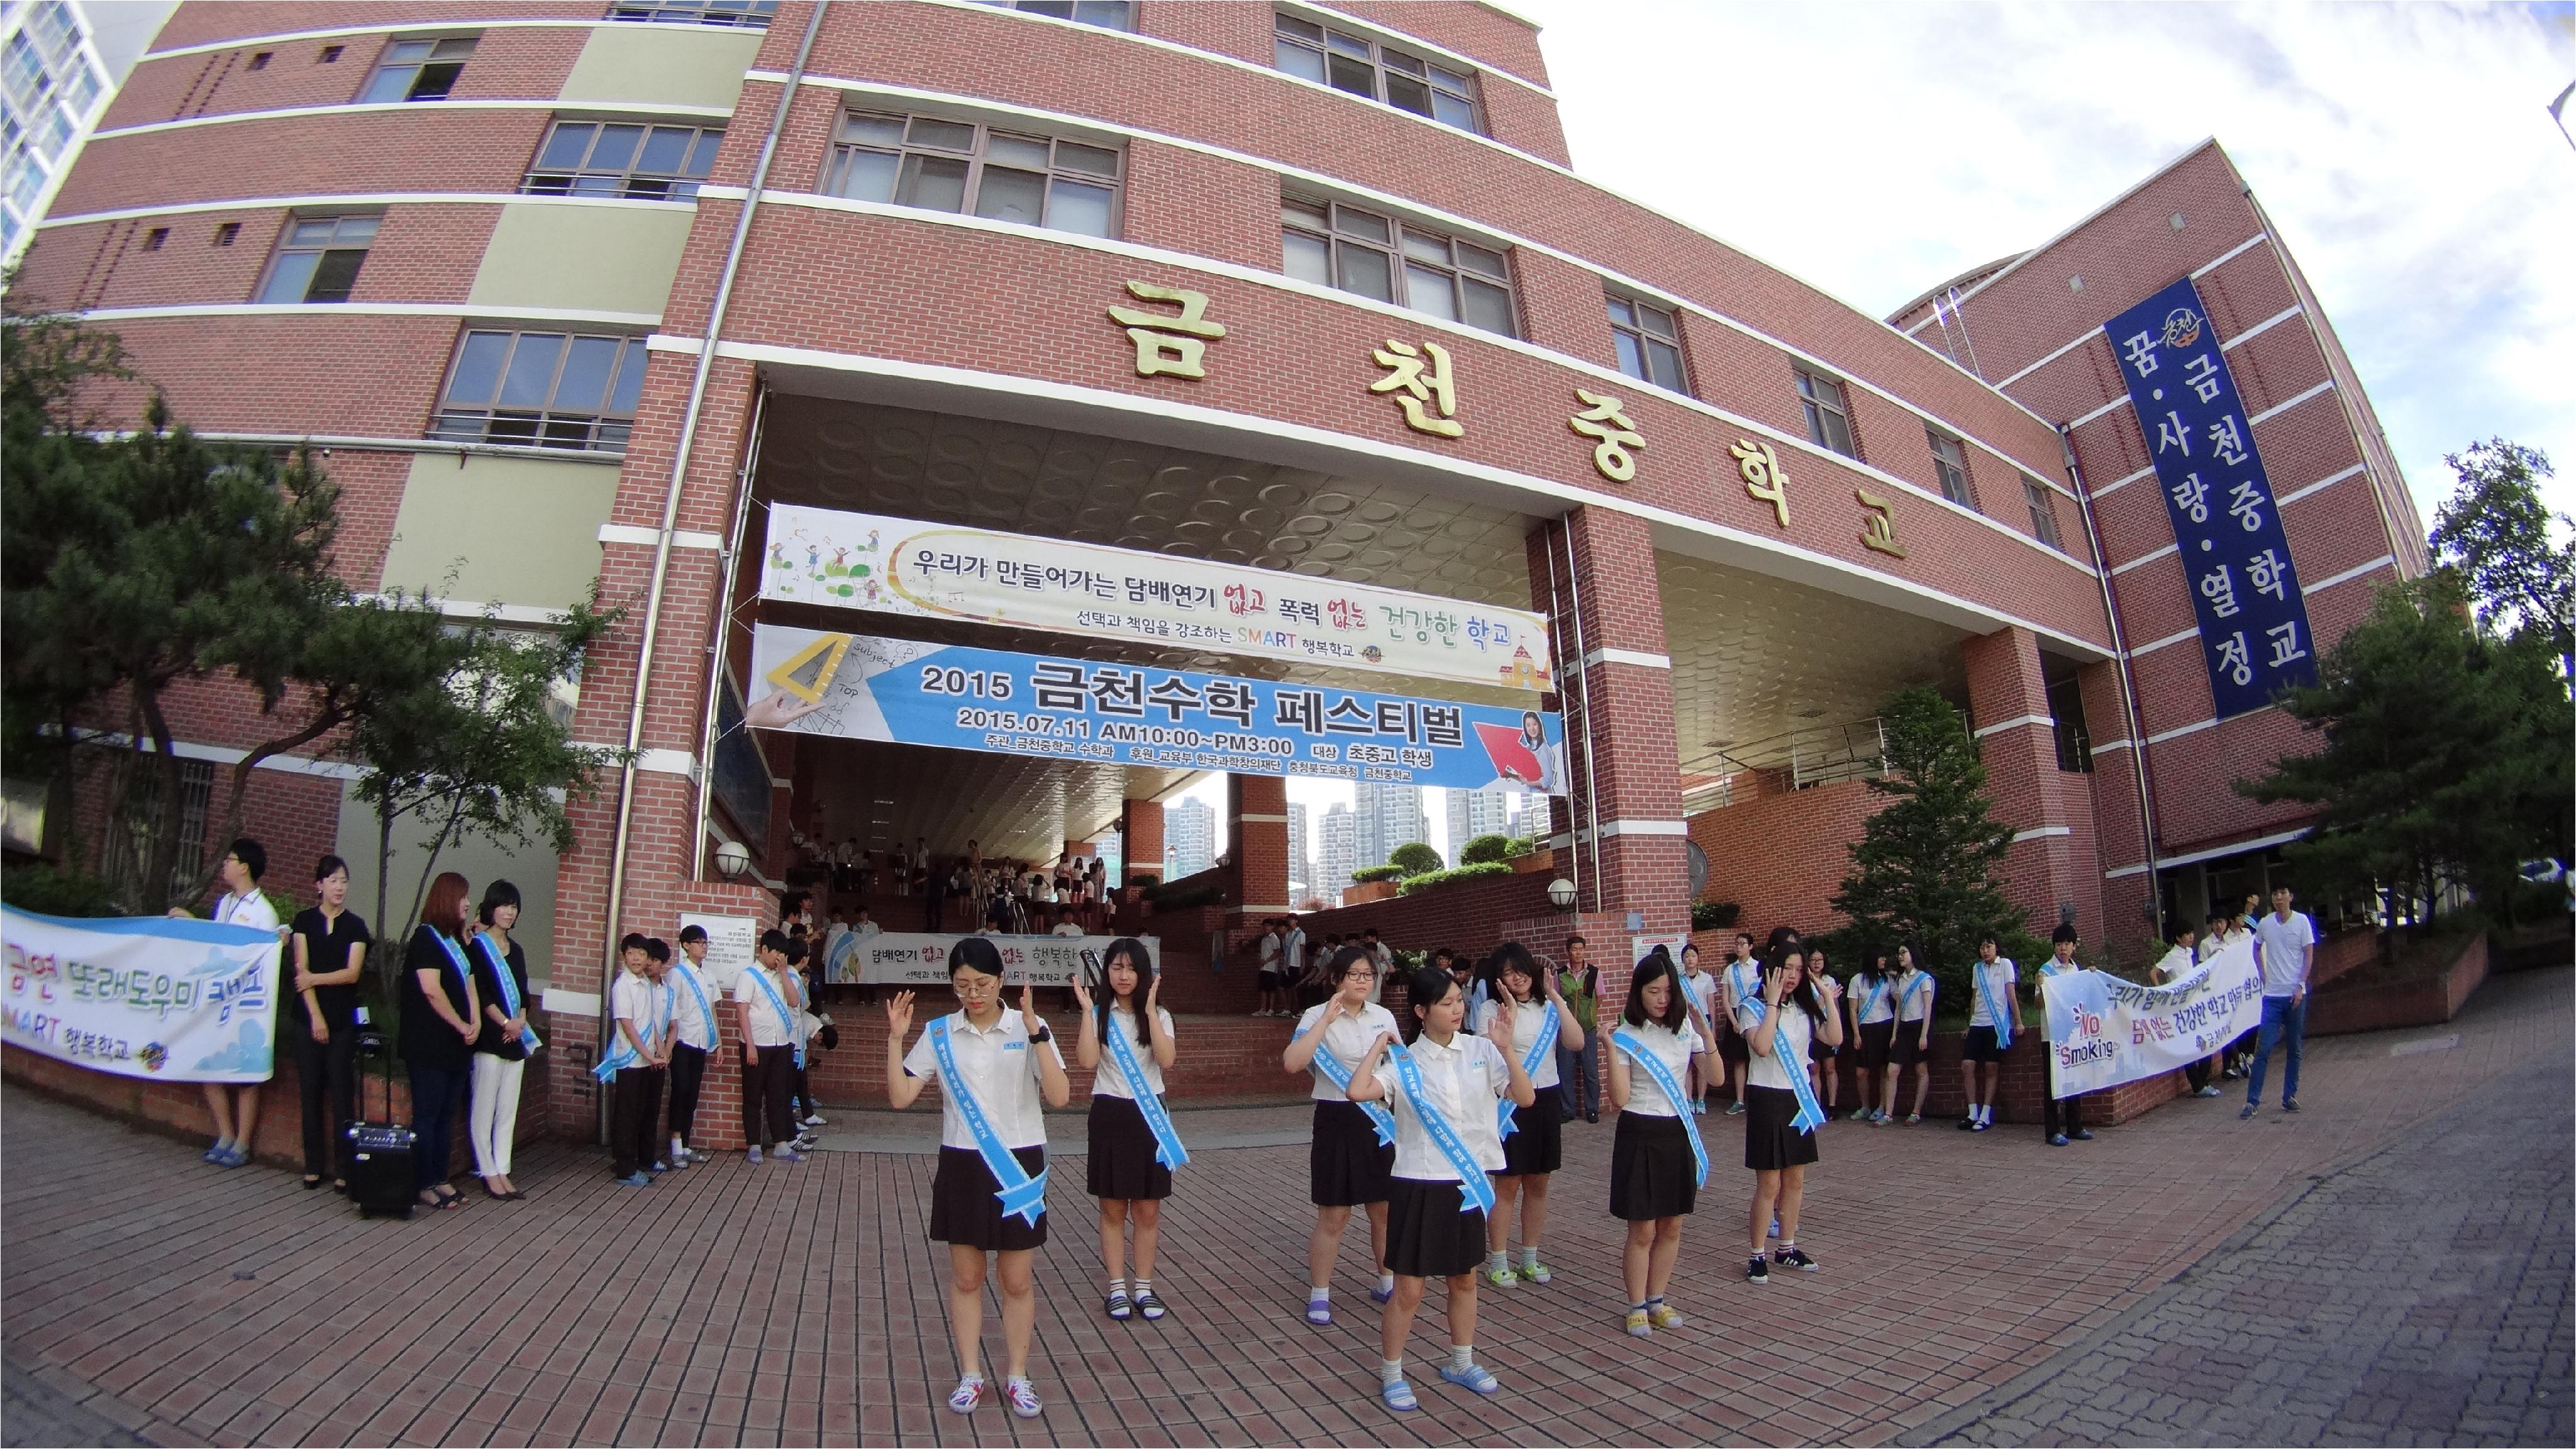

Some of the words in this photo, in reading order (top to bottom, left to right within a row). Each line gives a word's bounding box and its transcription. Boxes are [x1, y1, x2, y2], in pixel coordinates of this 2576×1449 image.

[1108, 279, 1908, 558] 금천중학교
[2185, 355, 2306, 667] 금천중학교
[914, 552, 988, 579] 우리가
[997, 560, 1116, 596] 만들어가는
[1125, 576, 1216, 608] 담배연기
[1224, 584, 1266, 616] 없고
[1279, 598, 1319, 626] 폭력
[1328, 598, 1367, 631] 없는
[1380, 605, 1457, 647] 건강한
[1466, 616, 1511, 650] 학교
[1077, 611, 1121, 628] 선택과
[1127, 616, 1170, 635] 책임을
[1175, 623, 1231, 643] 강조하는
[1238, 627, 1297, 648] SMART
[1302, 639, 1354, 657] 행복학교
[923, 667, 1010, 697] 2015
[1033, 662, 1255, 727] 금천수학
[1275, 690, 1463, 747] 페스티벌
[958, 709, 1089, 737] 2015.07.11
[1313, 745, 1336, 758] 대상
[1350, 745, 1397, 763] 초중고
[1401, 750, 1432, 767] 학생
[1079, 744, 1113, 757] 수학과
[1197, 753, 1280, 772] 한국과학창의재단
[1289, 762, 1357, 778] 충청북도교육청
[1365, 767, 1411, 781] 금천중학교
[872, 949, 917, 963] 담배연기
[922, 946, 945, 962] 없고
[1002, 947, 1024, 963] 없는
[1032, 947, 1077, 967] 행복한
[9, 943, 58, 999] 금연
[69, 961, 201, 1016] 또래도우미
[906, 970, 930, 980] 선택과
[933, 970, 949, 980] 책임
[1030, 973, 1060, 982] 행복학교
[2107, 983, 2144, 1009] 우리가
[2151, 1016, 2174, 1041] 없는
[2174, 1002, 2207, 1035] 건강한
[2207, 997, 2228, 1019] 학교
[65, 1027, 131, 1062] 행복학교
[2060, 1038, 2113, 1065] Smoking
